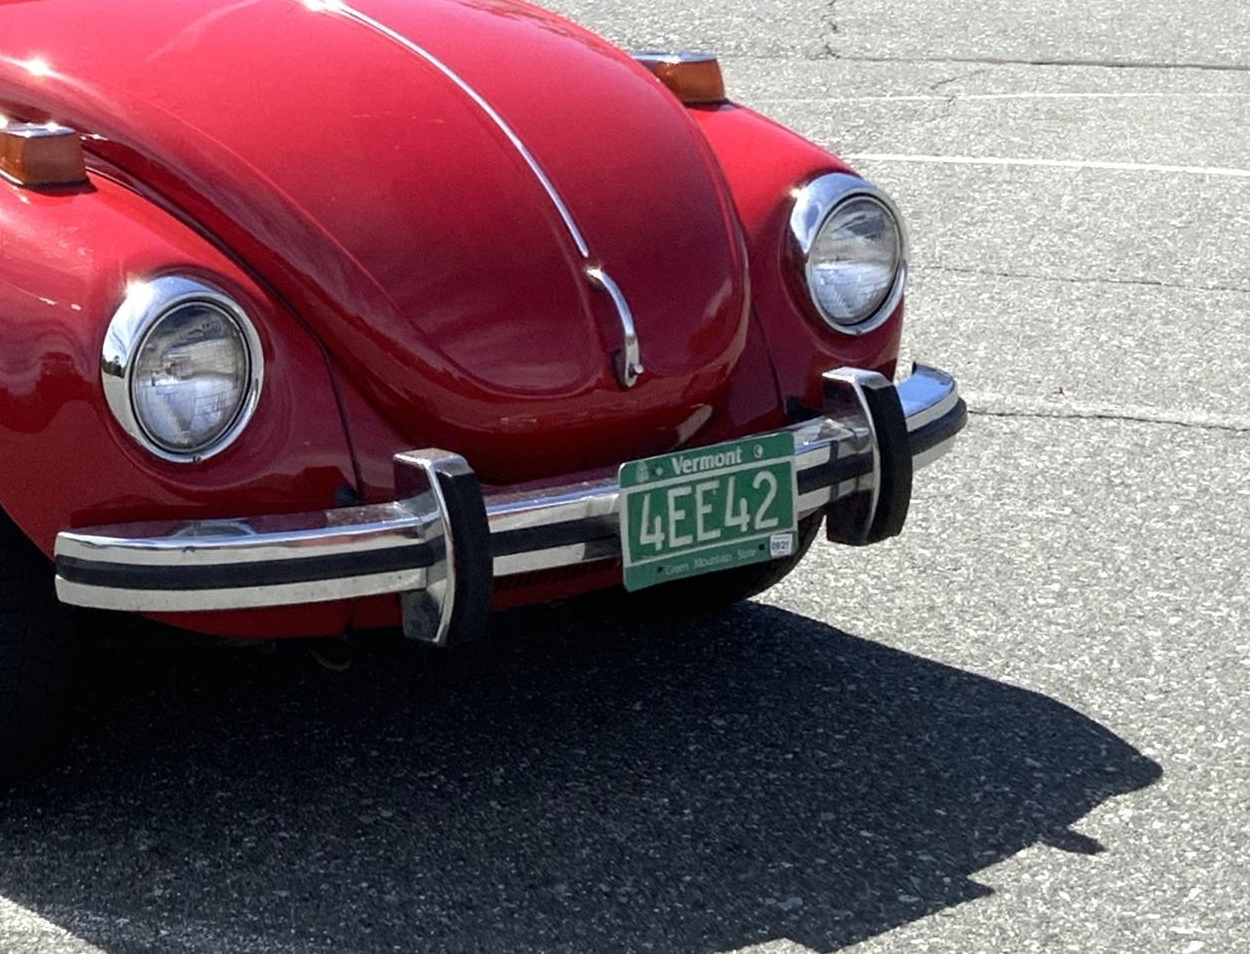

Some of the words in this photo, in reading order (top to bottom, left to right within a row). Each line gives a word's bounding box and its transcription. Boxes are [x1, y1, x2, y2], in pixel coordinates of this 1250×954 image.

[671, 446, 743, 475] Vermont
[639, 470, 779, 551] 4EE42
[665, 563, 689, 575] Green
[693, 553, 733, 569] Mountain
